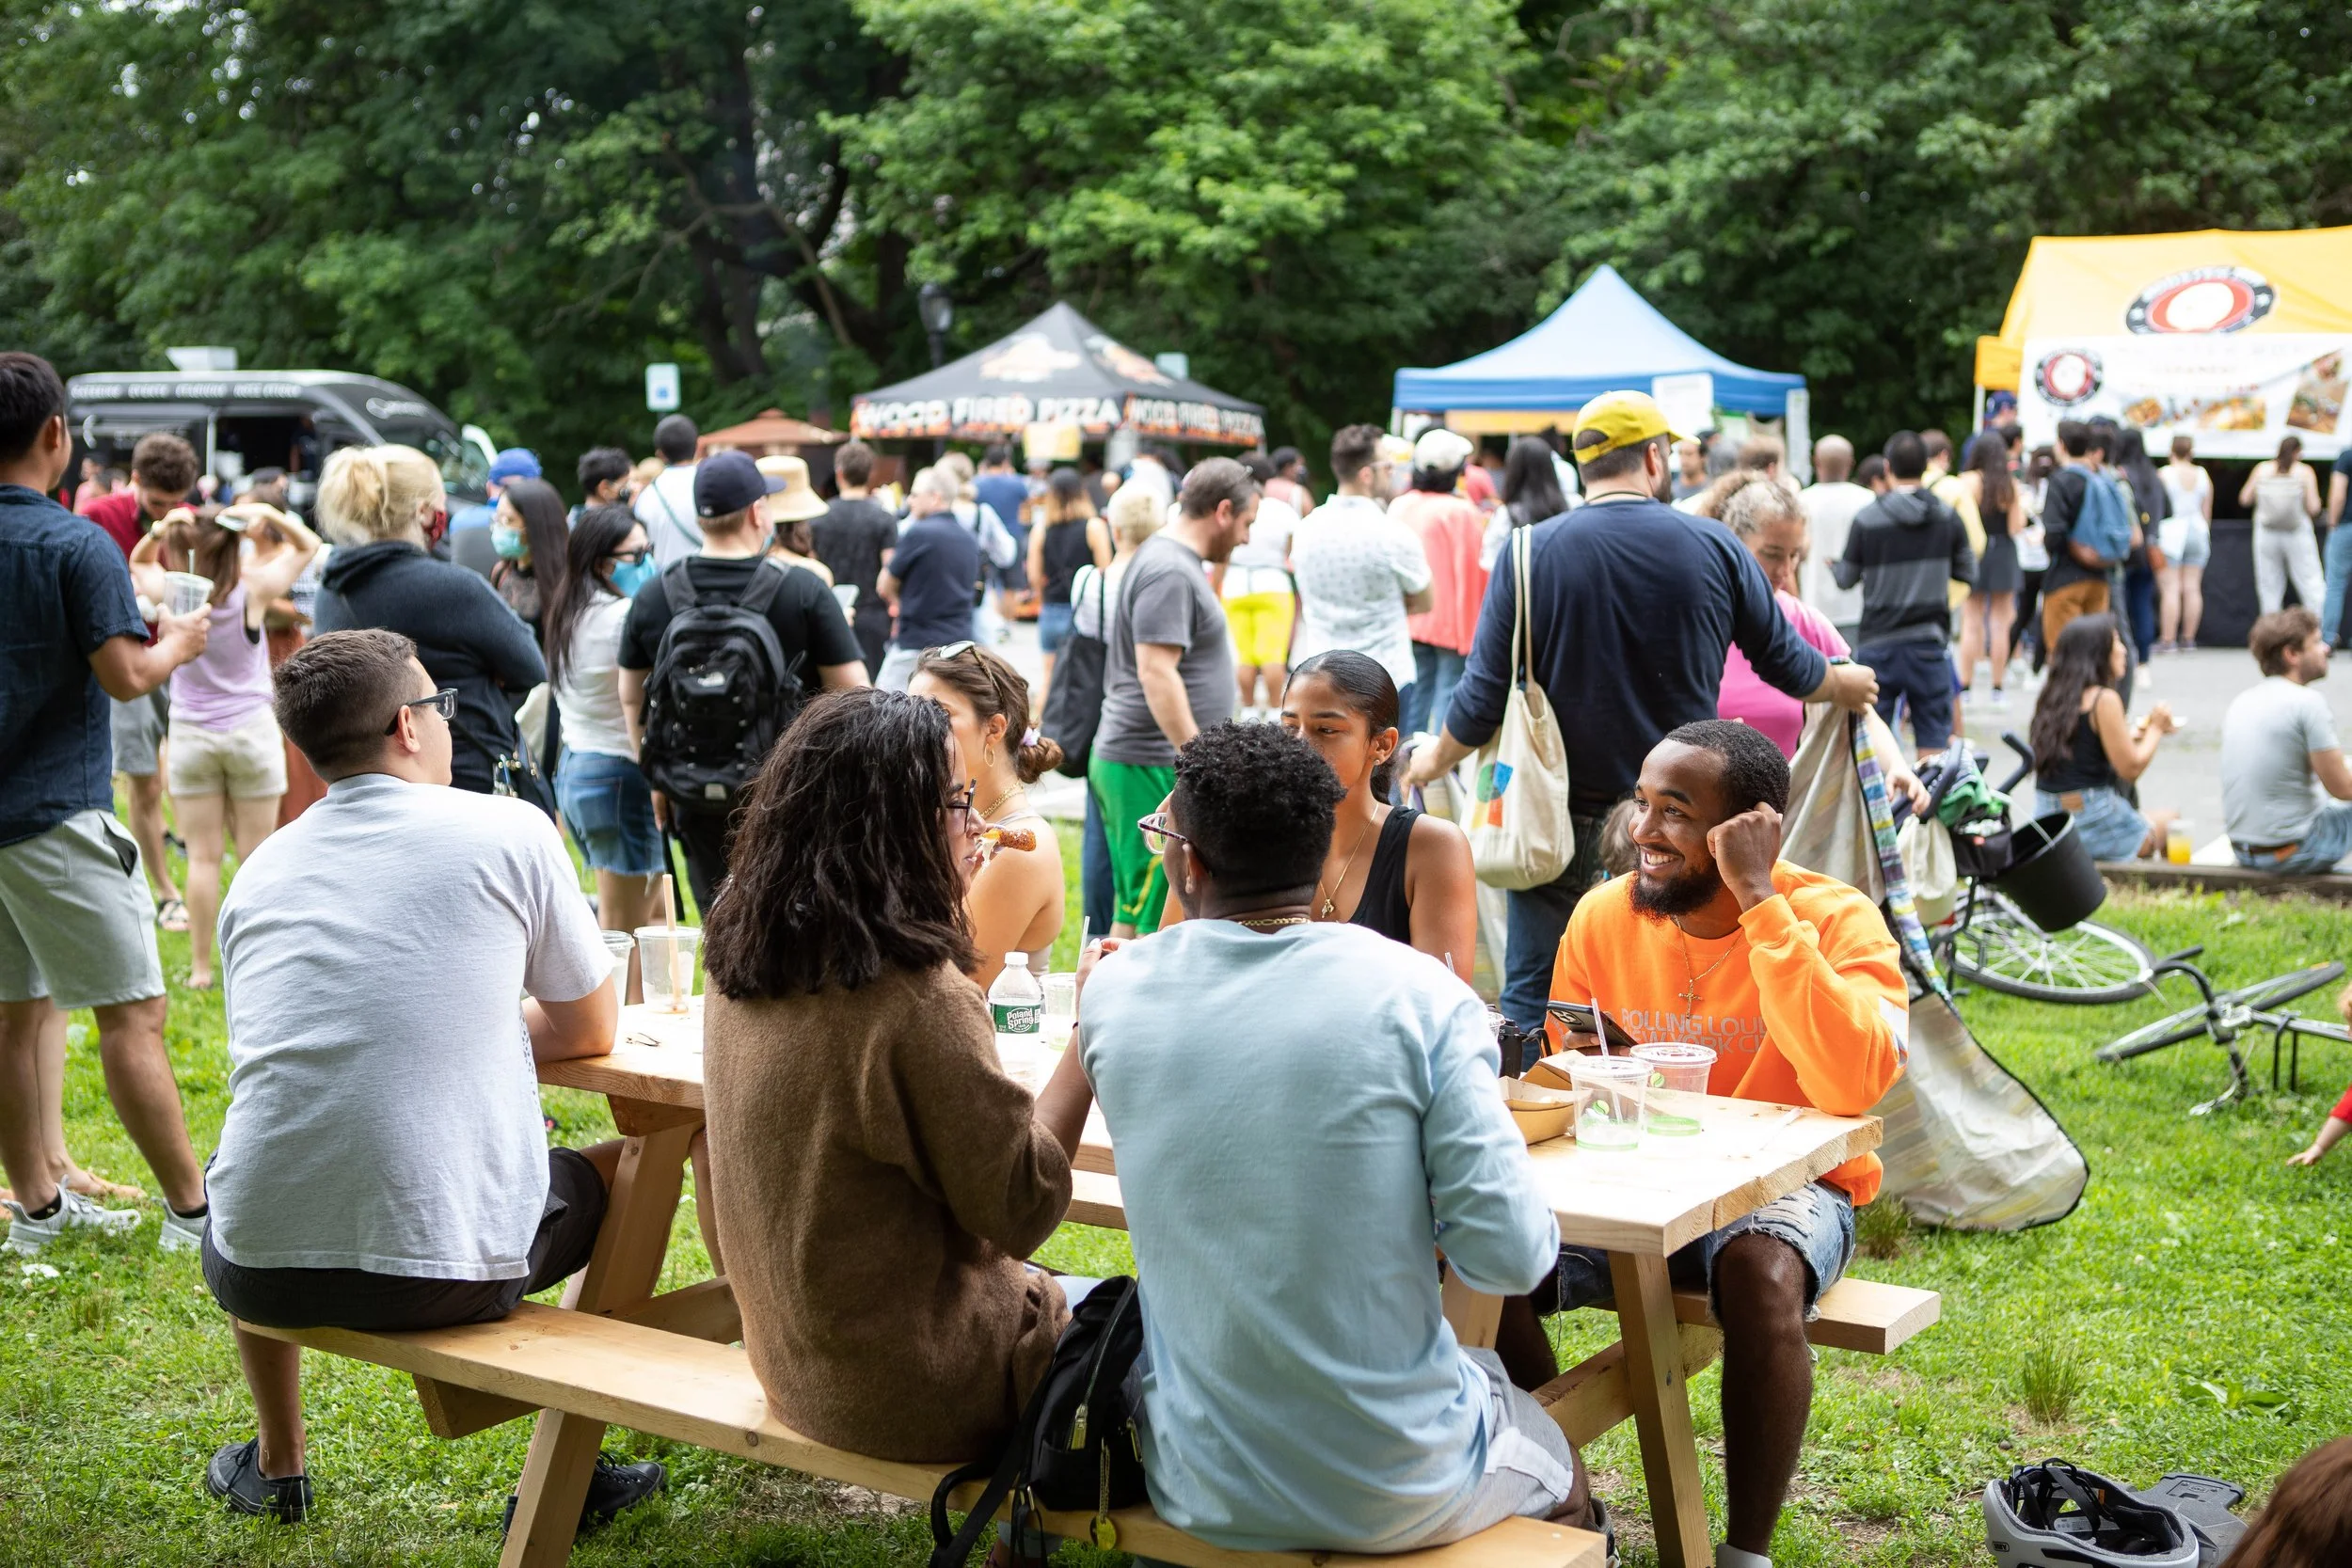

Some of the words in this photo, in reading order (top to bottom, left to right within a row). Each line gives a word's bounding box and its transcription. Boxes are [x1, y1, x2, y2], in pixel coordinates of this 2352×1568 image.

[854, 398, 949, 428] WOOD
[951, 395, 1034, 425] FIRED
[1037, 396, 1121, 424] PIZZA
[1007, 1007, 1033, 1022] Poland
[1008, 1016, 1034, 1030] Spring
[1621, 1007, 1703, 1036] ROLLING
